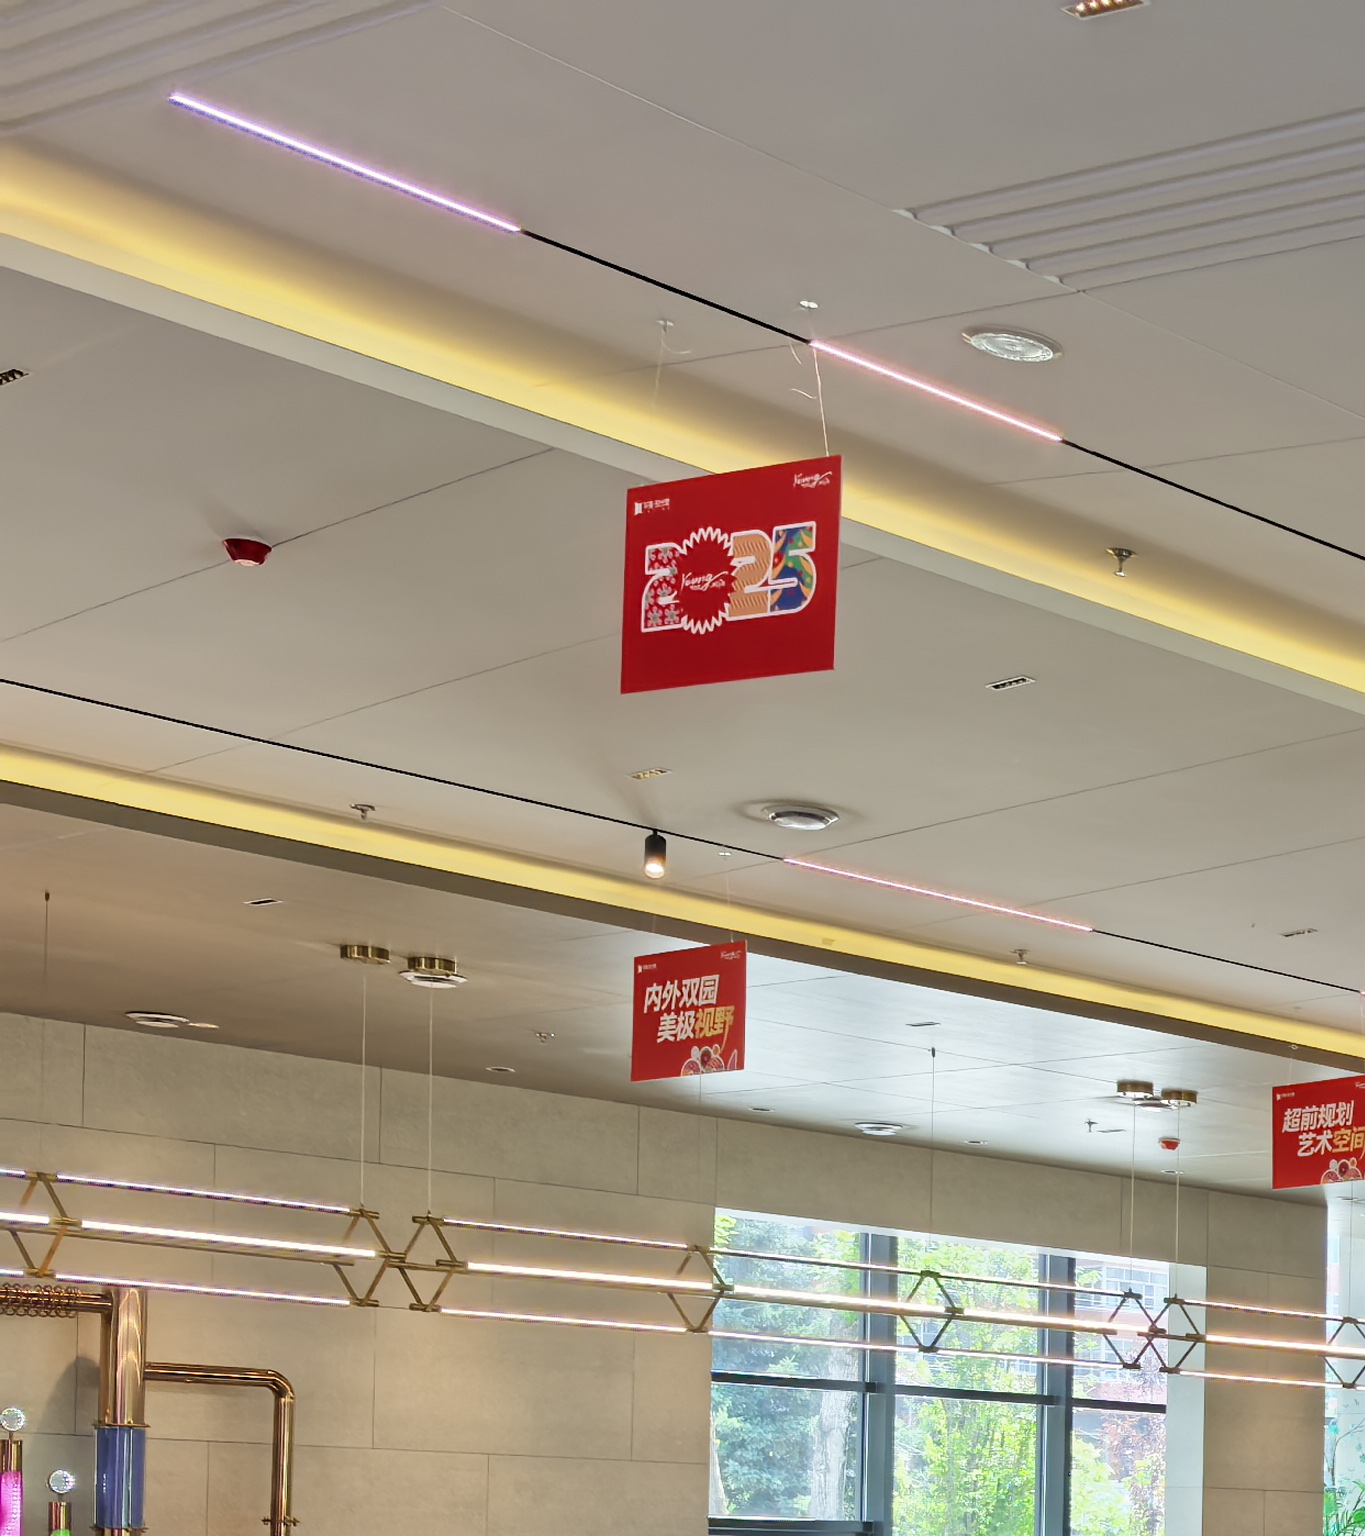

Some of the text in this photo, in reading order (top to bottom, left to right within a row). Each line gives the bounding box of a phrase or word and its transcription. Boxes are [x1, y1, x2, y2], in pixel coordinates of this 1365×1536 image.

[644, 974, 720, 1013] 内外双园
[656, 1005, 735, 1054] 美极视野
[1282, 1100, 1354, 1133] 超前规划
